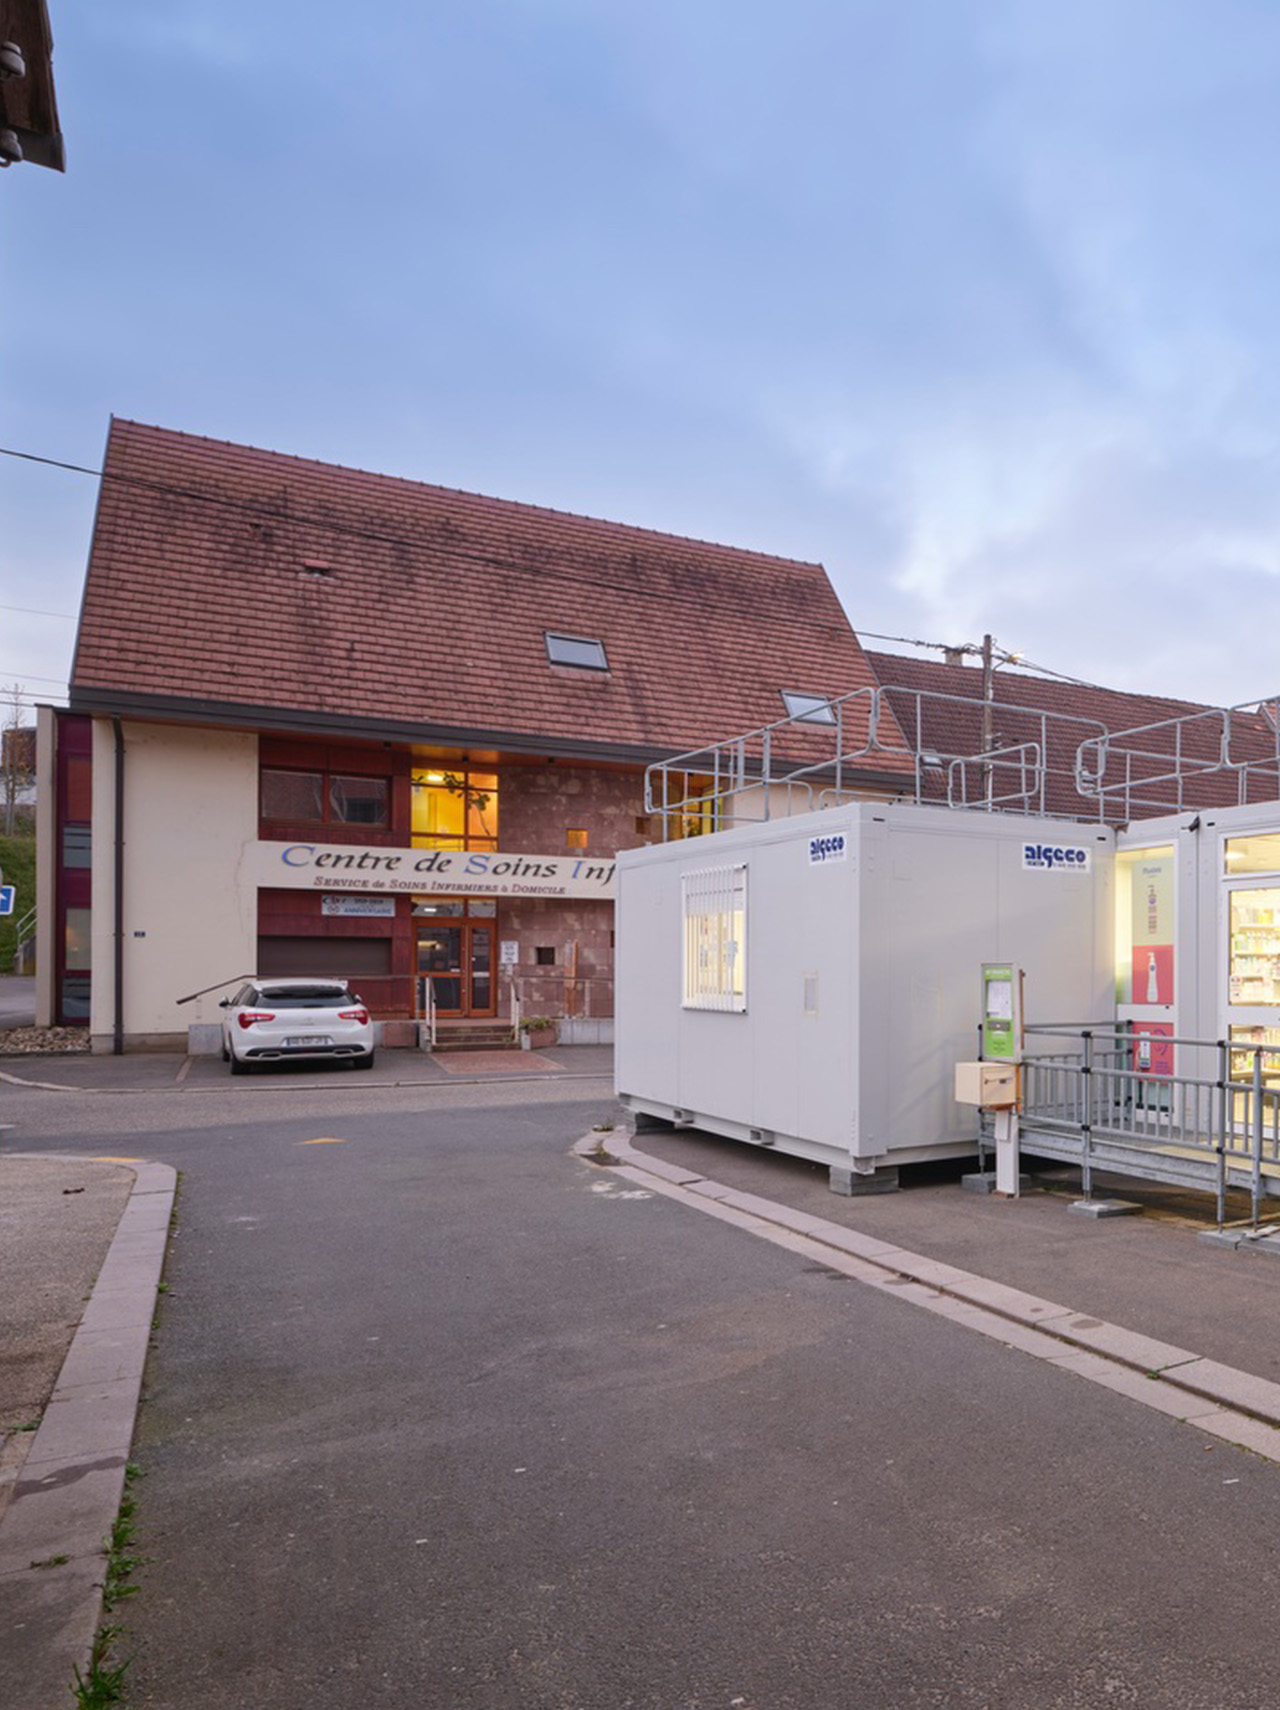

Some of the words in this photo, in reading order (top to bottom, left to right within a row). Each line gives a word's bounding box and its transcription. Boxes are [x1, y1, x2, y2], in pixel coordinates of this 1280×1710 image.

[281, 845, 402, 871] Centre
[414, 851, 452, 873] de
[463, 854, 558, 878] Soins
